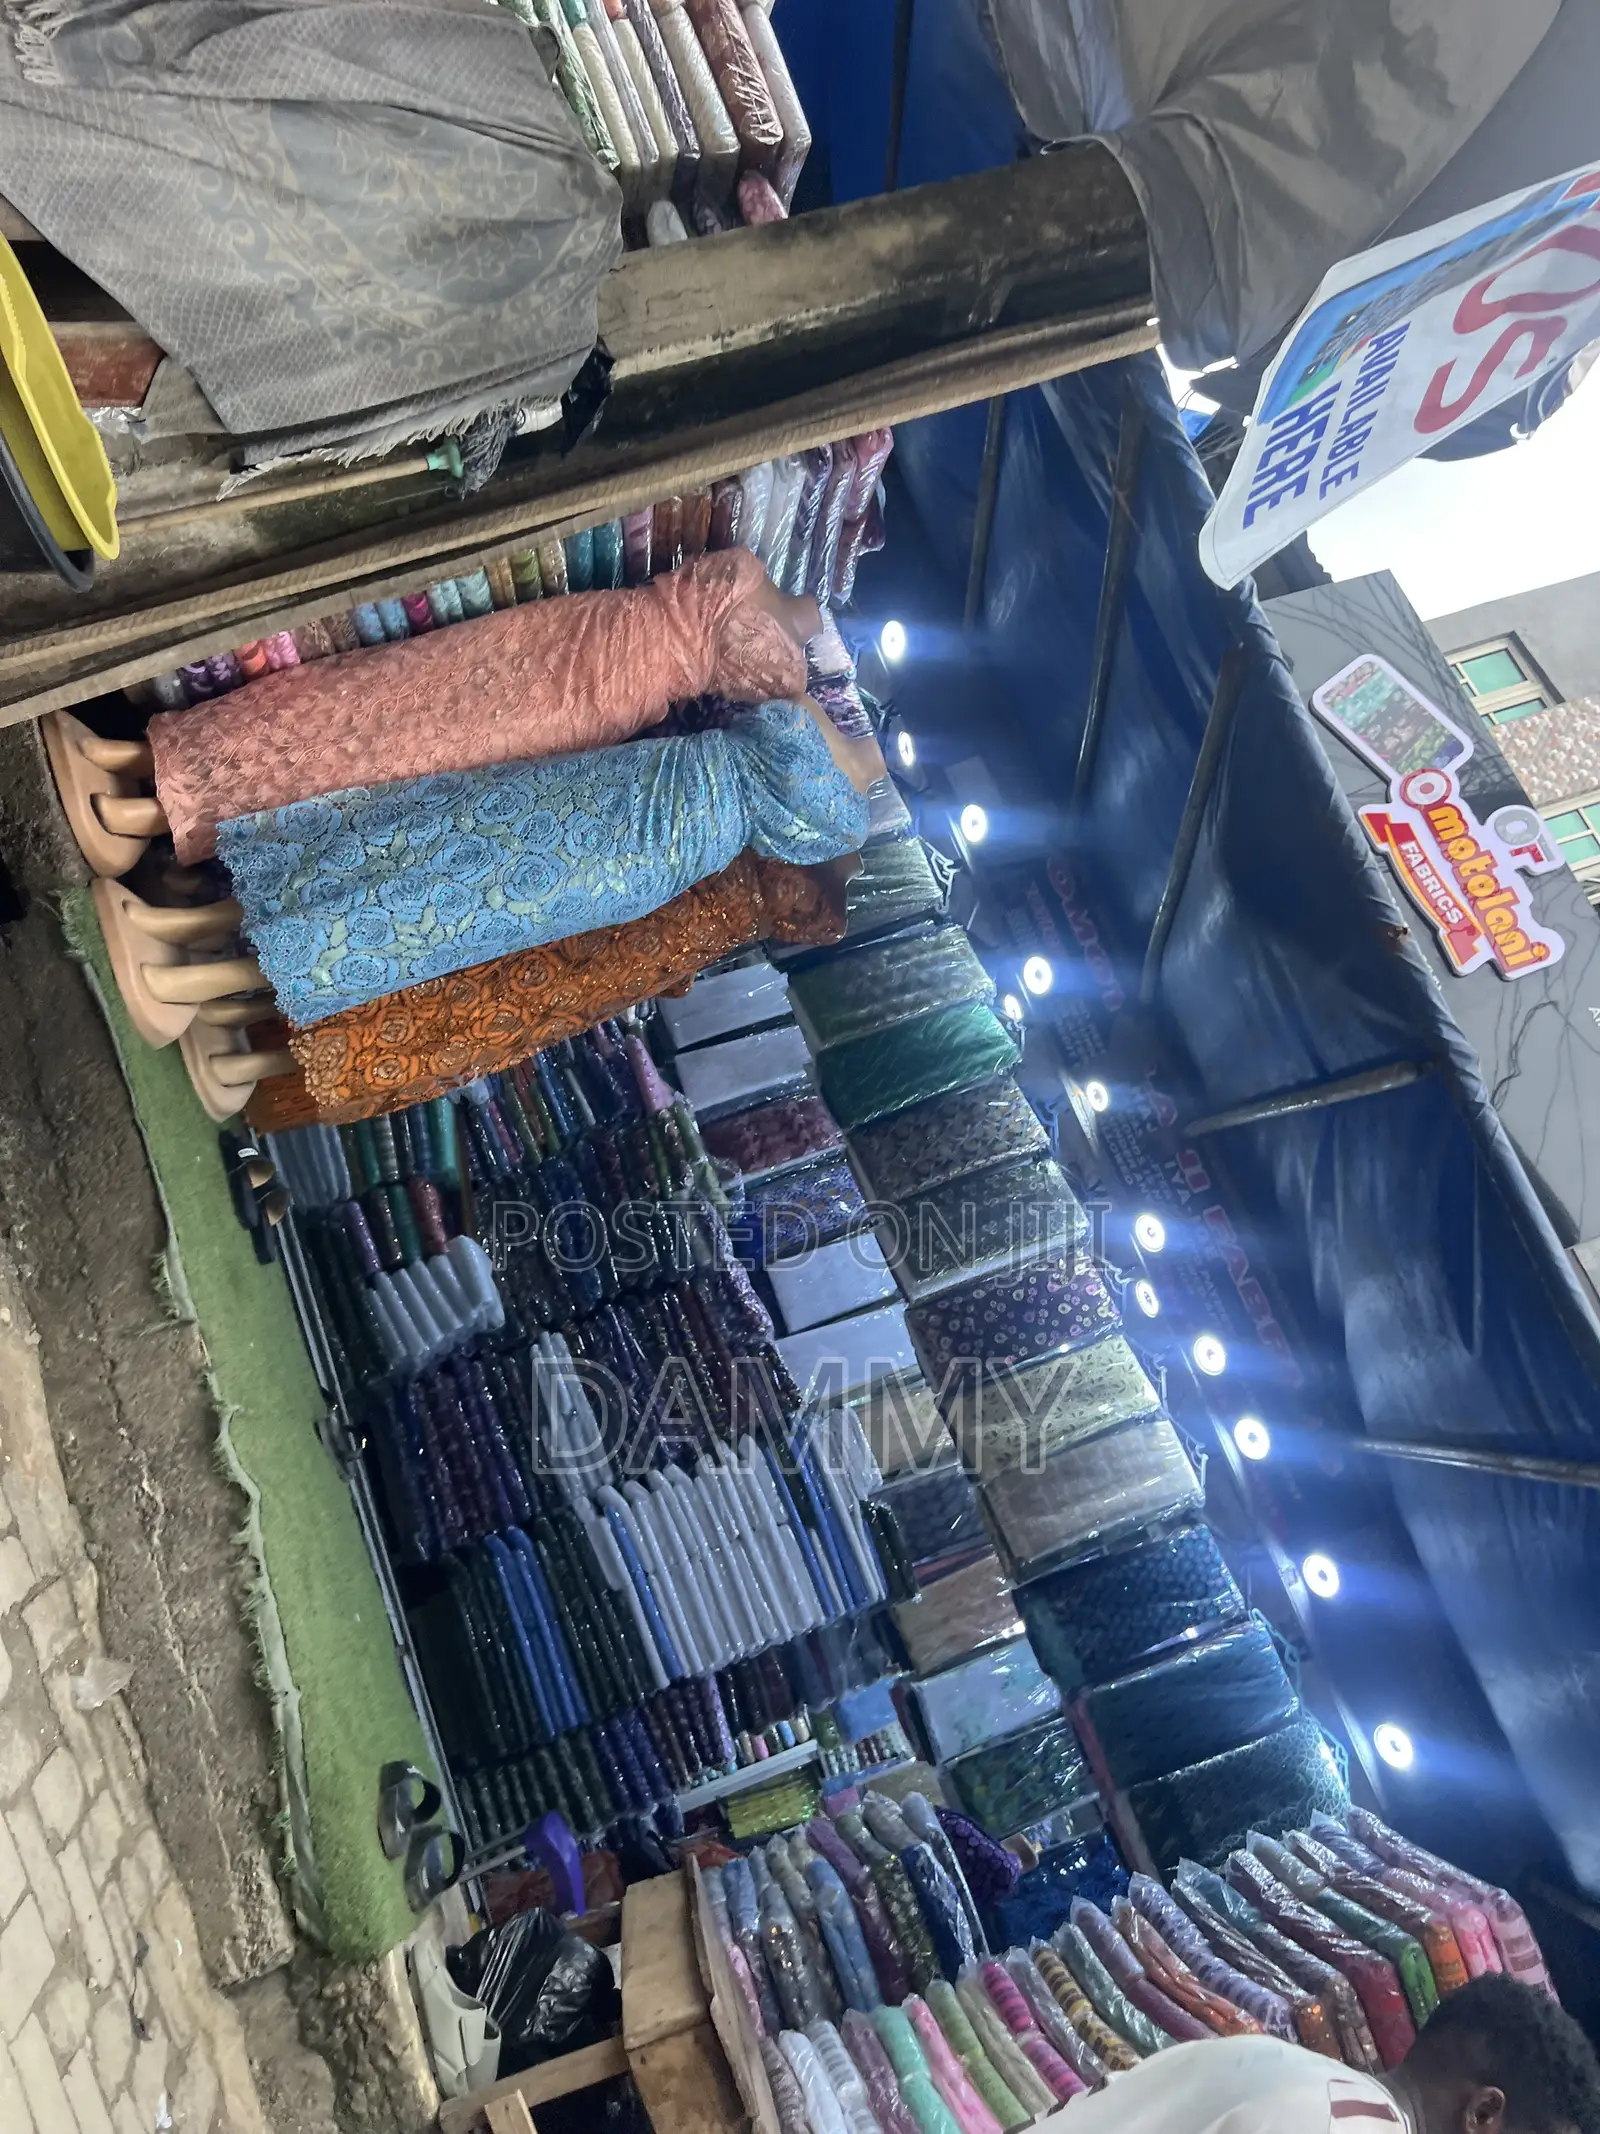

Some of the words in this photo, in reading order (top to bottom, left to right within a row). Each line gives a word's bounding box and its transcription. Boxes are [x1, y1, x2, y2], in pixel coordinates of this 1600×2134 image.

[1413, 212, 1600, 434] OS
[1242, 380, 1342, 531] HERE
[1318, 320, 1411, 501] AVAILABLE
[1398, 840, 1464, 925] FABRICS
